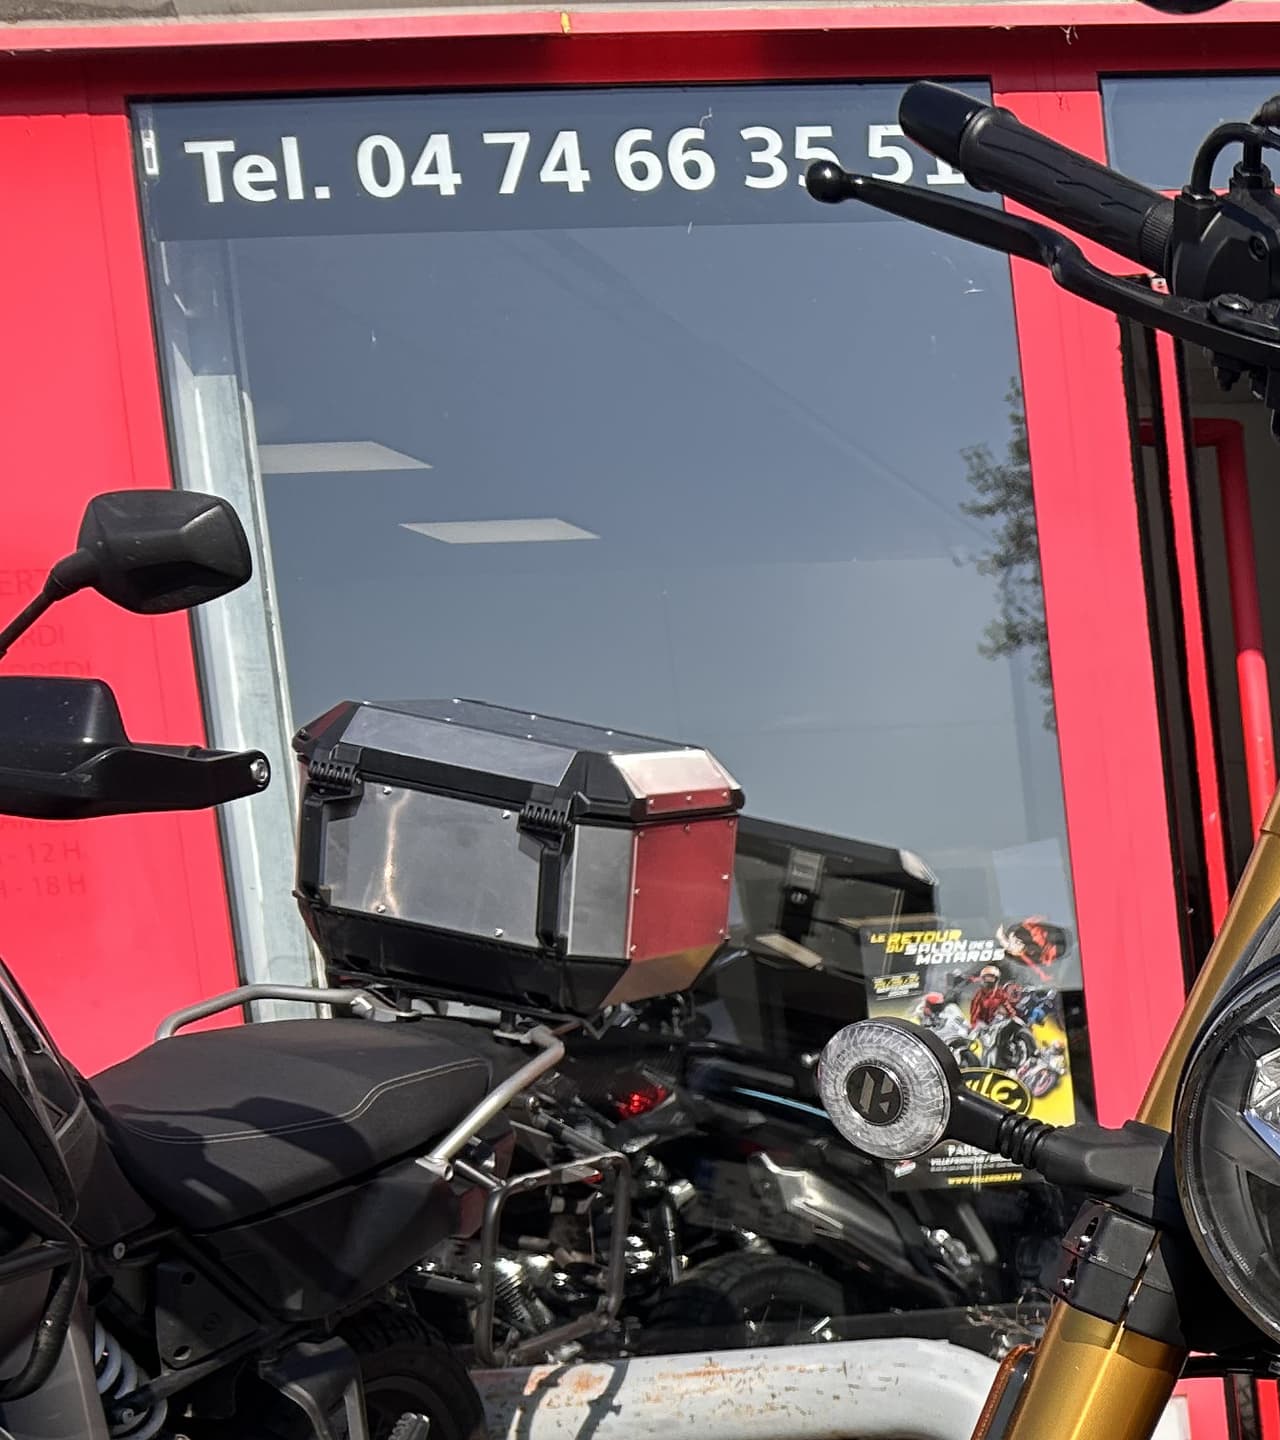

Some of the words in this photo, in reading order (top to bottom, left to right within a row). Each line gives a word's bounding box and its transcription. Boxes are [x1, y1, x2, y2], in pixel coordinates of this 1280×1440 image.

[184, 136, 330, 204] Tel.
[357, 133, 462, 199] 04
[482, 129, 592, 194] 74
[614, 127, 717, 193] 66
[887, 929, 962, 946] RETOUR
[886, 943, 905, 953] DU
[904, 939, 968, 956] SALON
[915, 949, 1005, 966] MOTARDS
